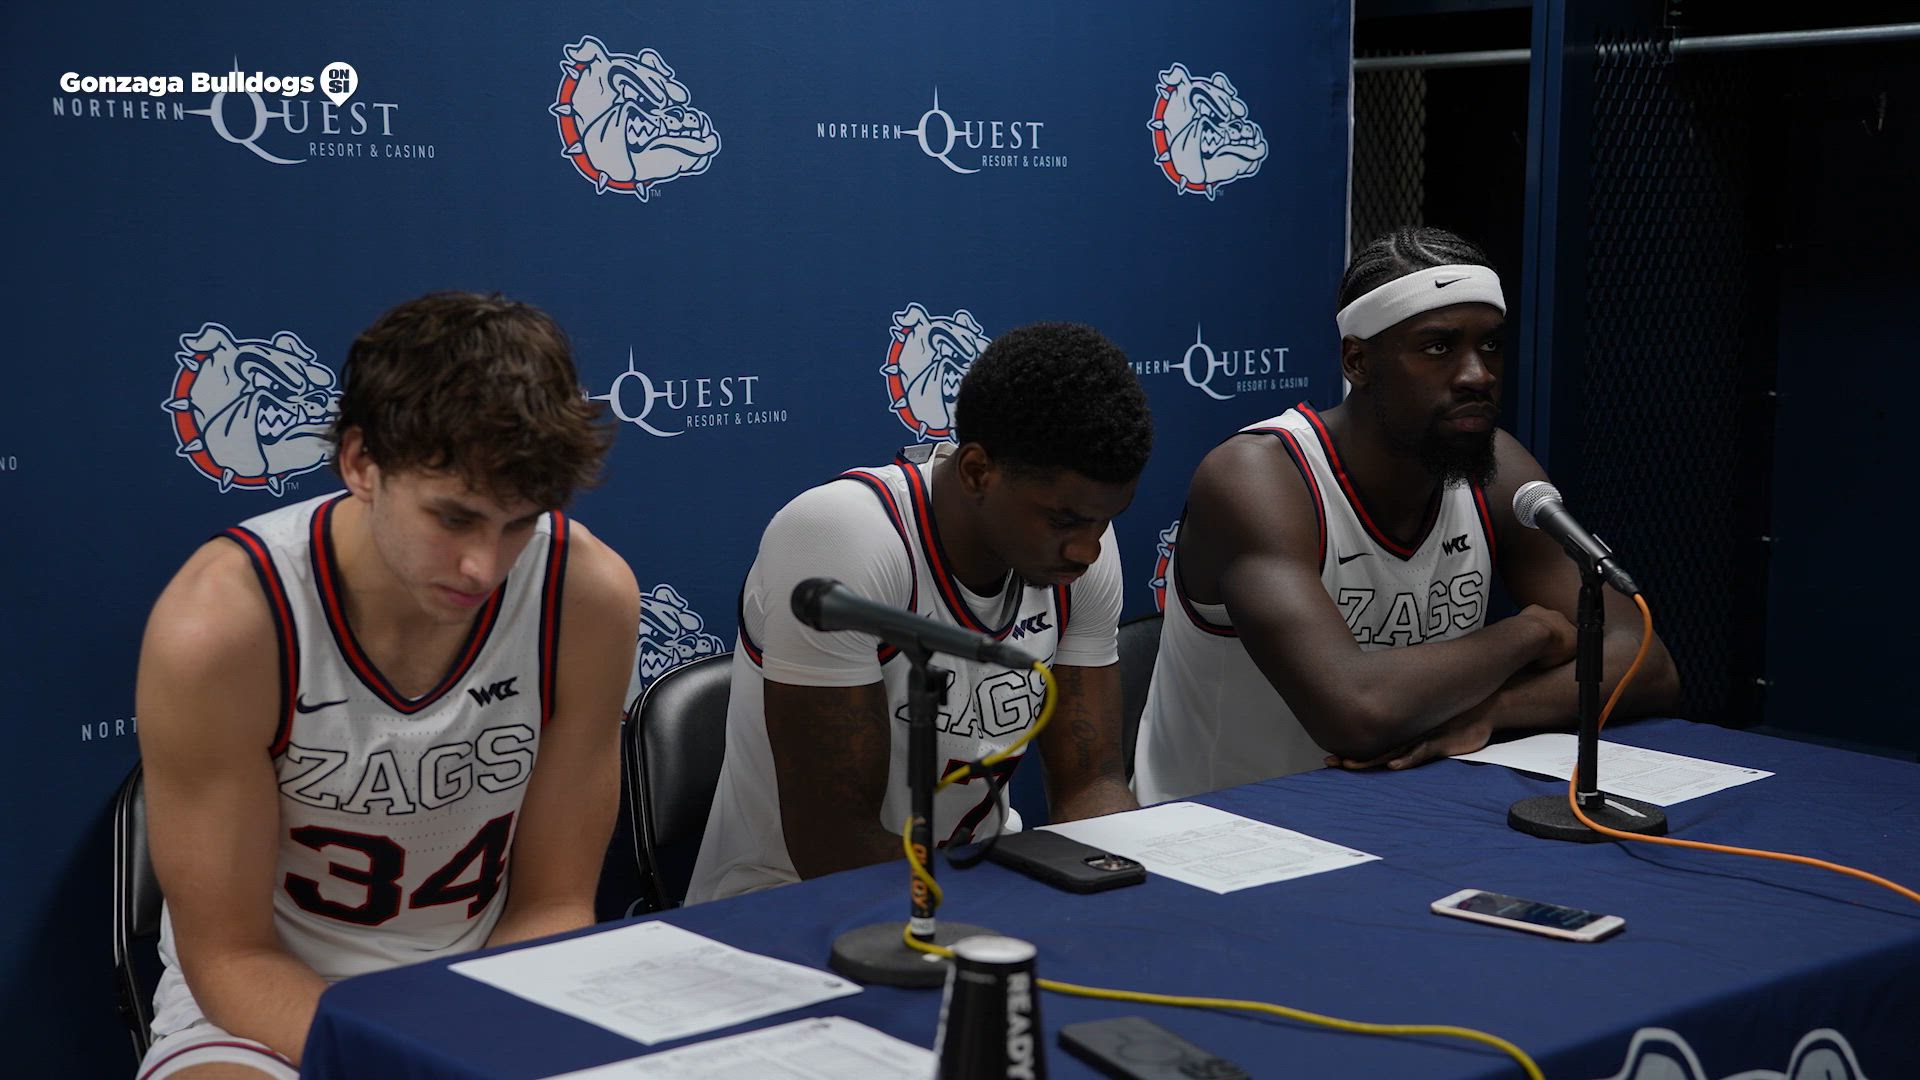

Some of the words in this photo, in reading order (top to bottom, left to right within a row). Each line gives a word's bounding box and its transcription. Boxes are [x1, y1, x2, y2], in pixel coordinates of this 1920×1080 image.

[52, 96, 184, 121] NORTHERN
[208, 91, 399, 165] QUEST
[309, 142, 362, 157] RESORT
[370, 144, 379, 158] &
[385, 144, 435, 159] CASINO
[817, 122, 901, 139] NORTHERN
[917, 108, 1044, 174] QUEST
[982, 155, 1019, 167] RESORT
[1022, 156, 1029, 167] &
[1033, 155, 1068, 168] CASINO
[609, 370, 759, 438] QUEST
[1127, 359, 1170, 376] THERN
[1182, 342, 1290, 400] QUEST
[1236, 379, 1267, 392] RESORT
[1270, 378, 1277, 391] &
[1279, 376, 1309, 390] CASINO
[686, 413, 729, 428] RESORT
[735, 412, 742, 425] &
[747, 409, 788, 425] CASINO
[1337, 570, 1484, 647] ZAGS
[81, 716, 137, 741] NORT
[279, 723, 535, 815] ZAGS
[937, 753, 1025, 849] 7
[284, 811, 515, 926] 34
